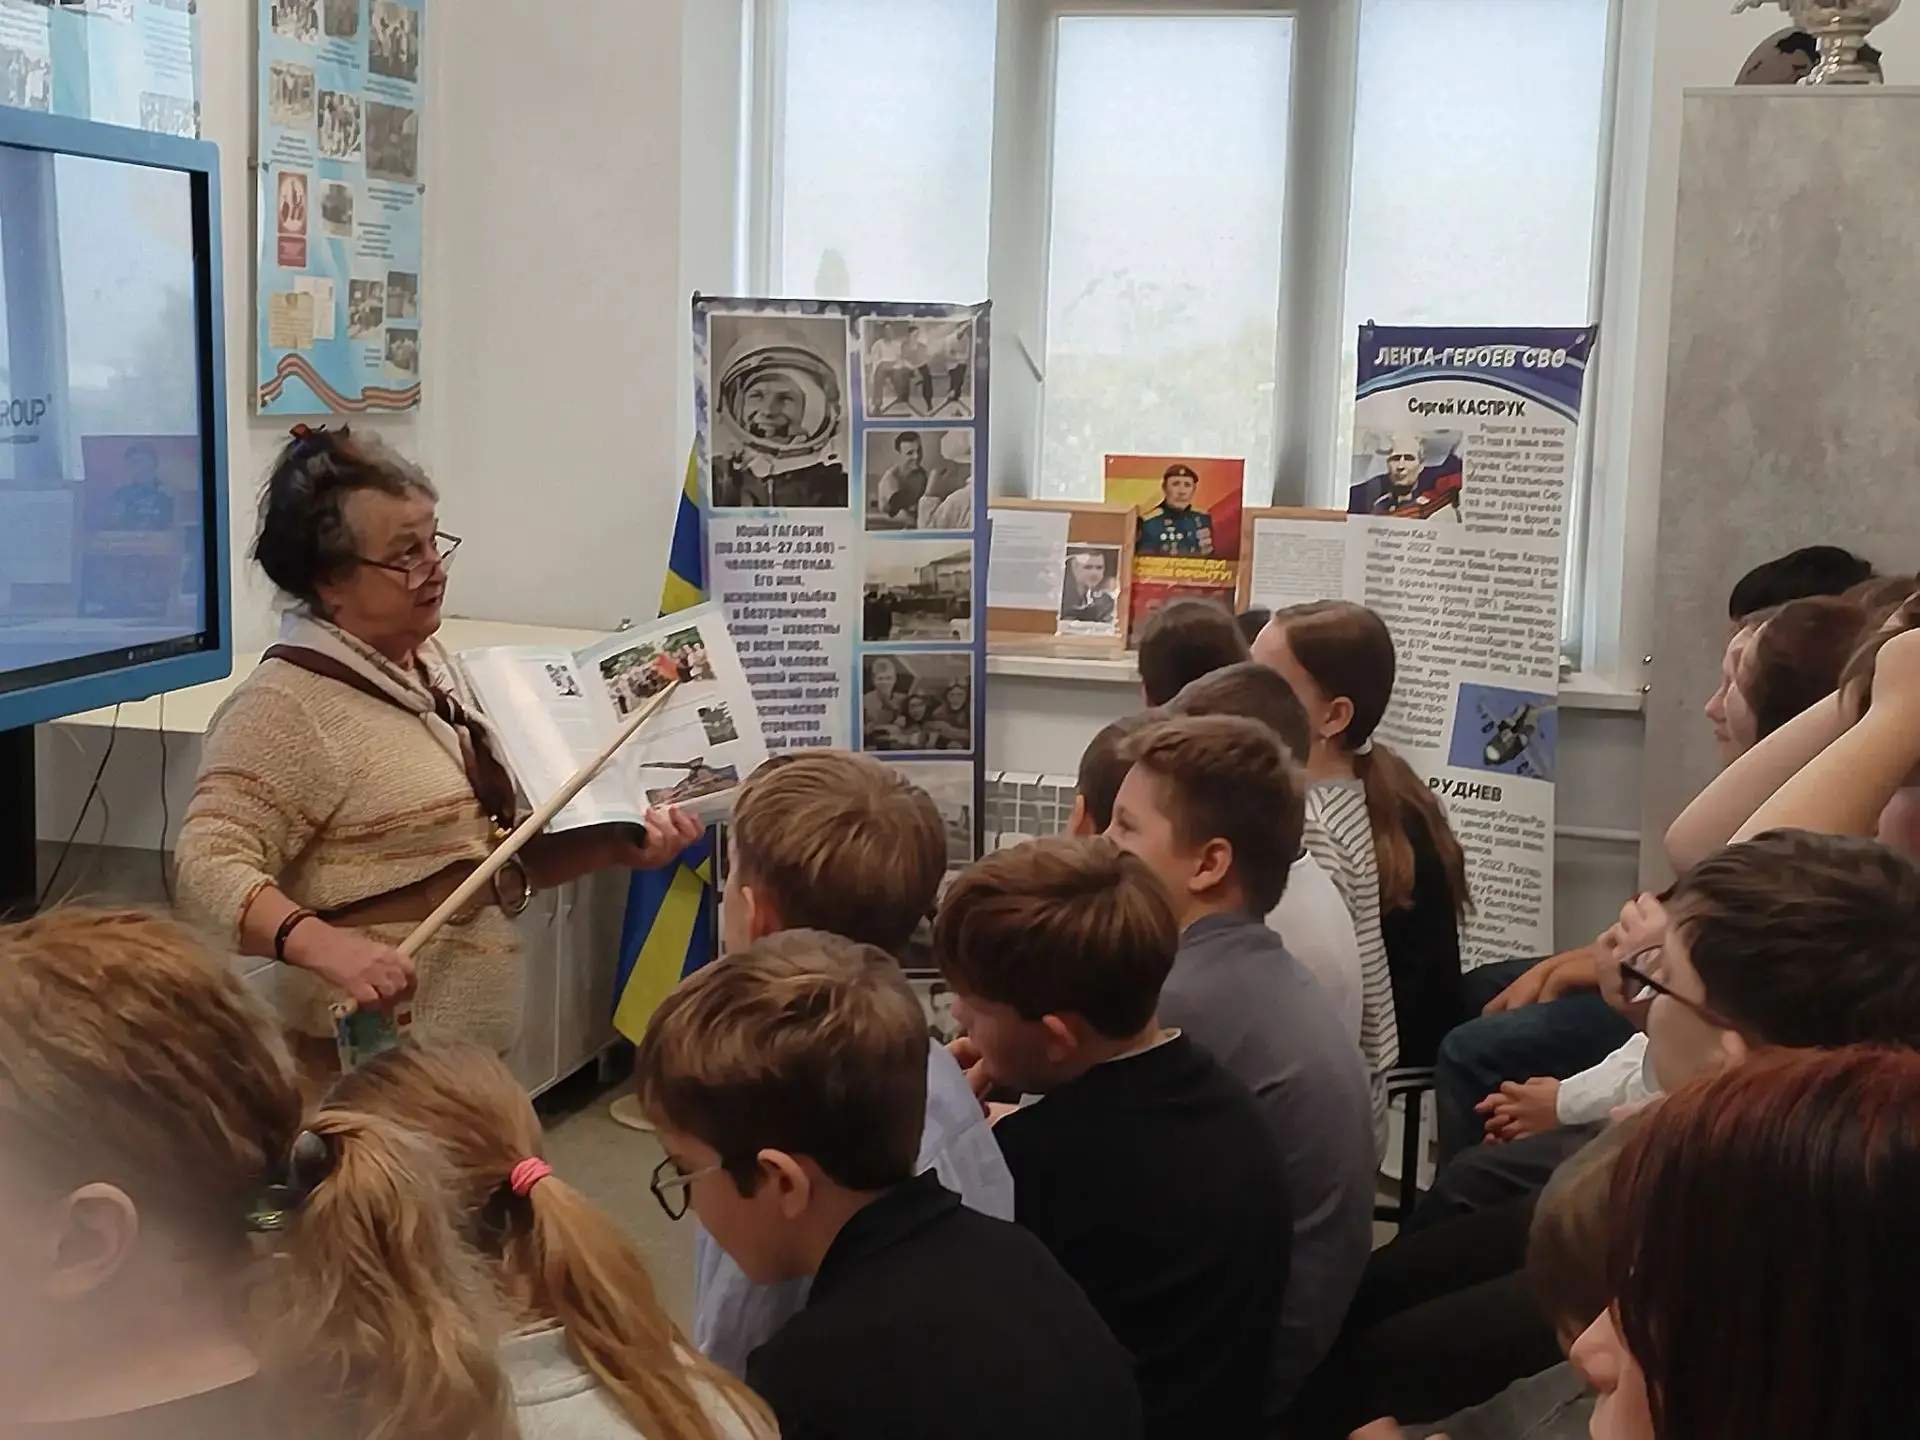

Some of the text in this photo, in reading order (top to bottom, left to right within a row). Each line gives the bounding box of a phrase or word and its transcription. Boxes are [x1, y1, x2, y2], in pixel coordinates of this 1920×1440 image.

[1374, 346, 1567, 369] ЛЕНТА ГЕРОЕВ СВО
[1407, 397, 1526, 418] Сергей КАСПРУК
[772, 524, 825, 538] ГАГАРИН
[754, 573, 773, 587] Его
[790, 590, 837, 604] улыбка
[1428, 776, 1503, 803] РУДНЕВ
